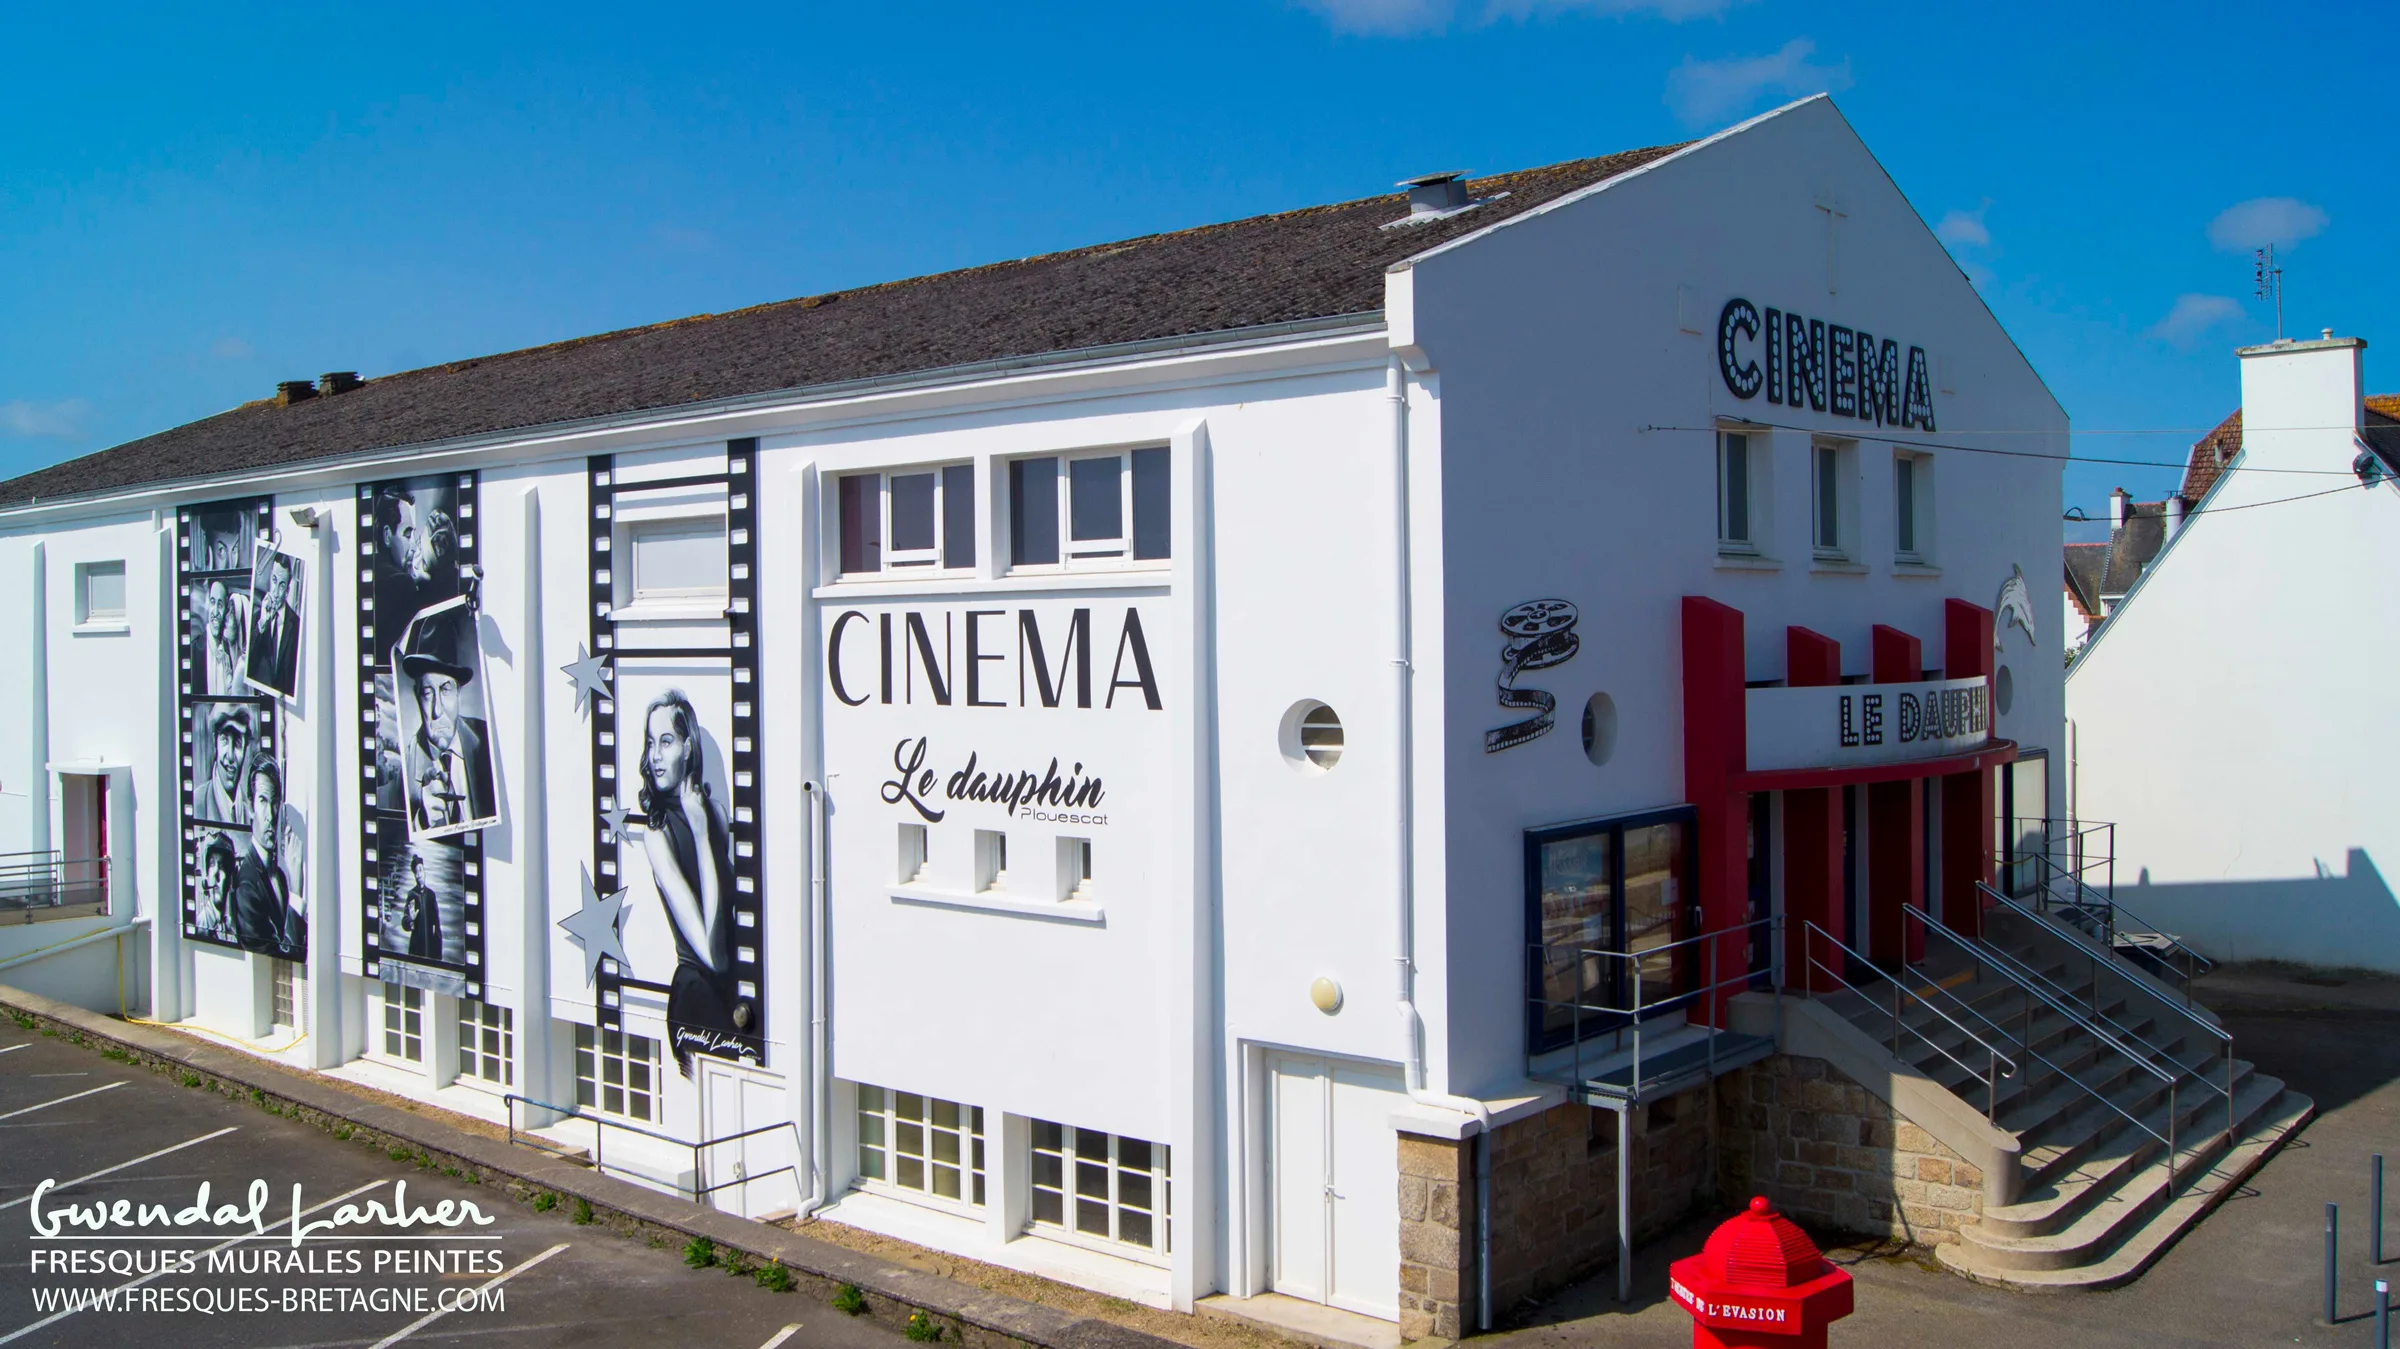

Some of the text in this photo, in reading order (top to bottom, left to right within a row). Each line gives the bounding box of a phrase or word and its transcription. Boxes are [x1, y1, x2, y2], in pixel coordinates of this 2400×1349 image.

[1718, 297, 1936, 432] CINEMA
[828, 607, 1163, 710] CINEMA
[1840, 684, 1989, 747] LE DAUPHI
[881, 736, 1105, 823] Le dauphin
[1020, 807, 1108, 825] Plouescat
[1708, 1303, 1786, 1322] L'EVASION
